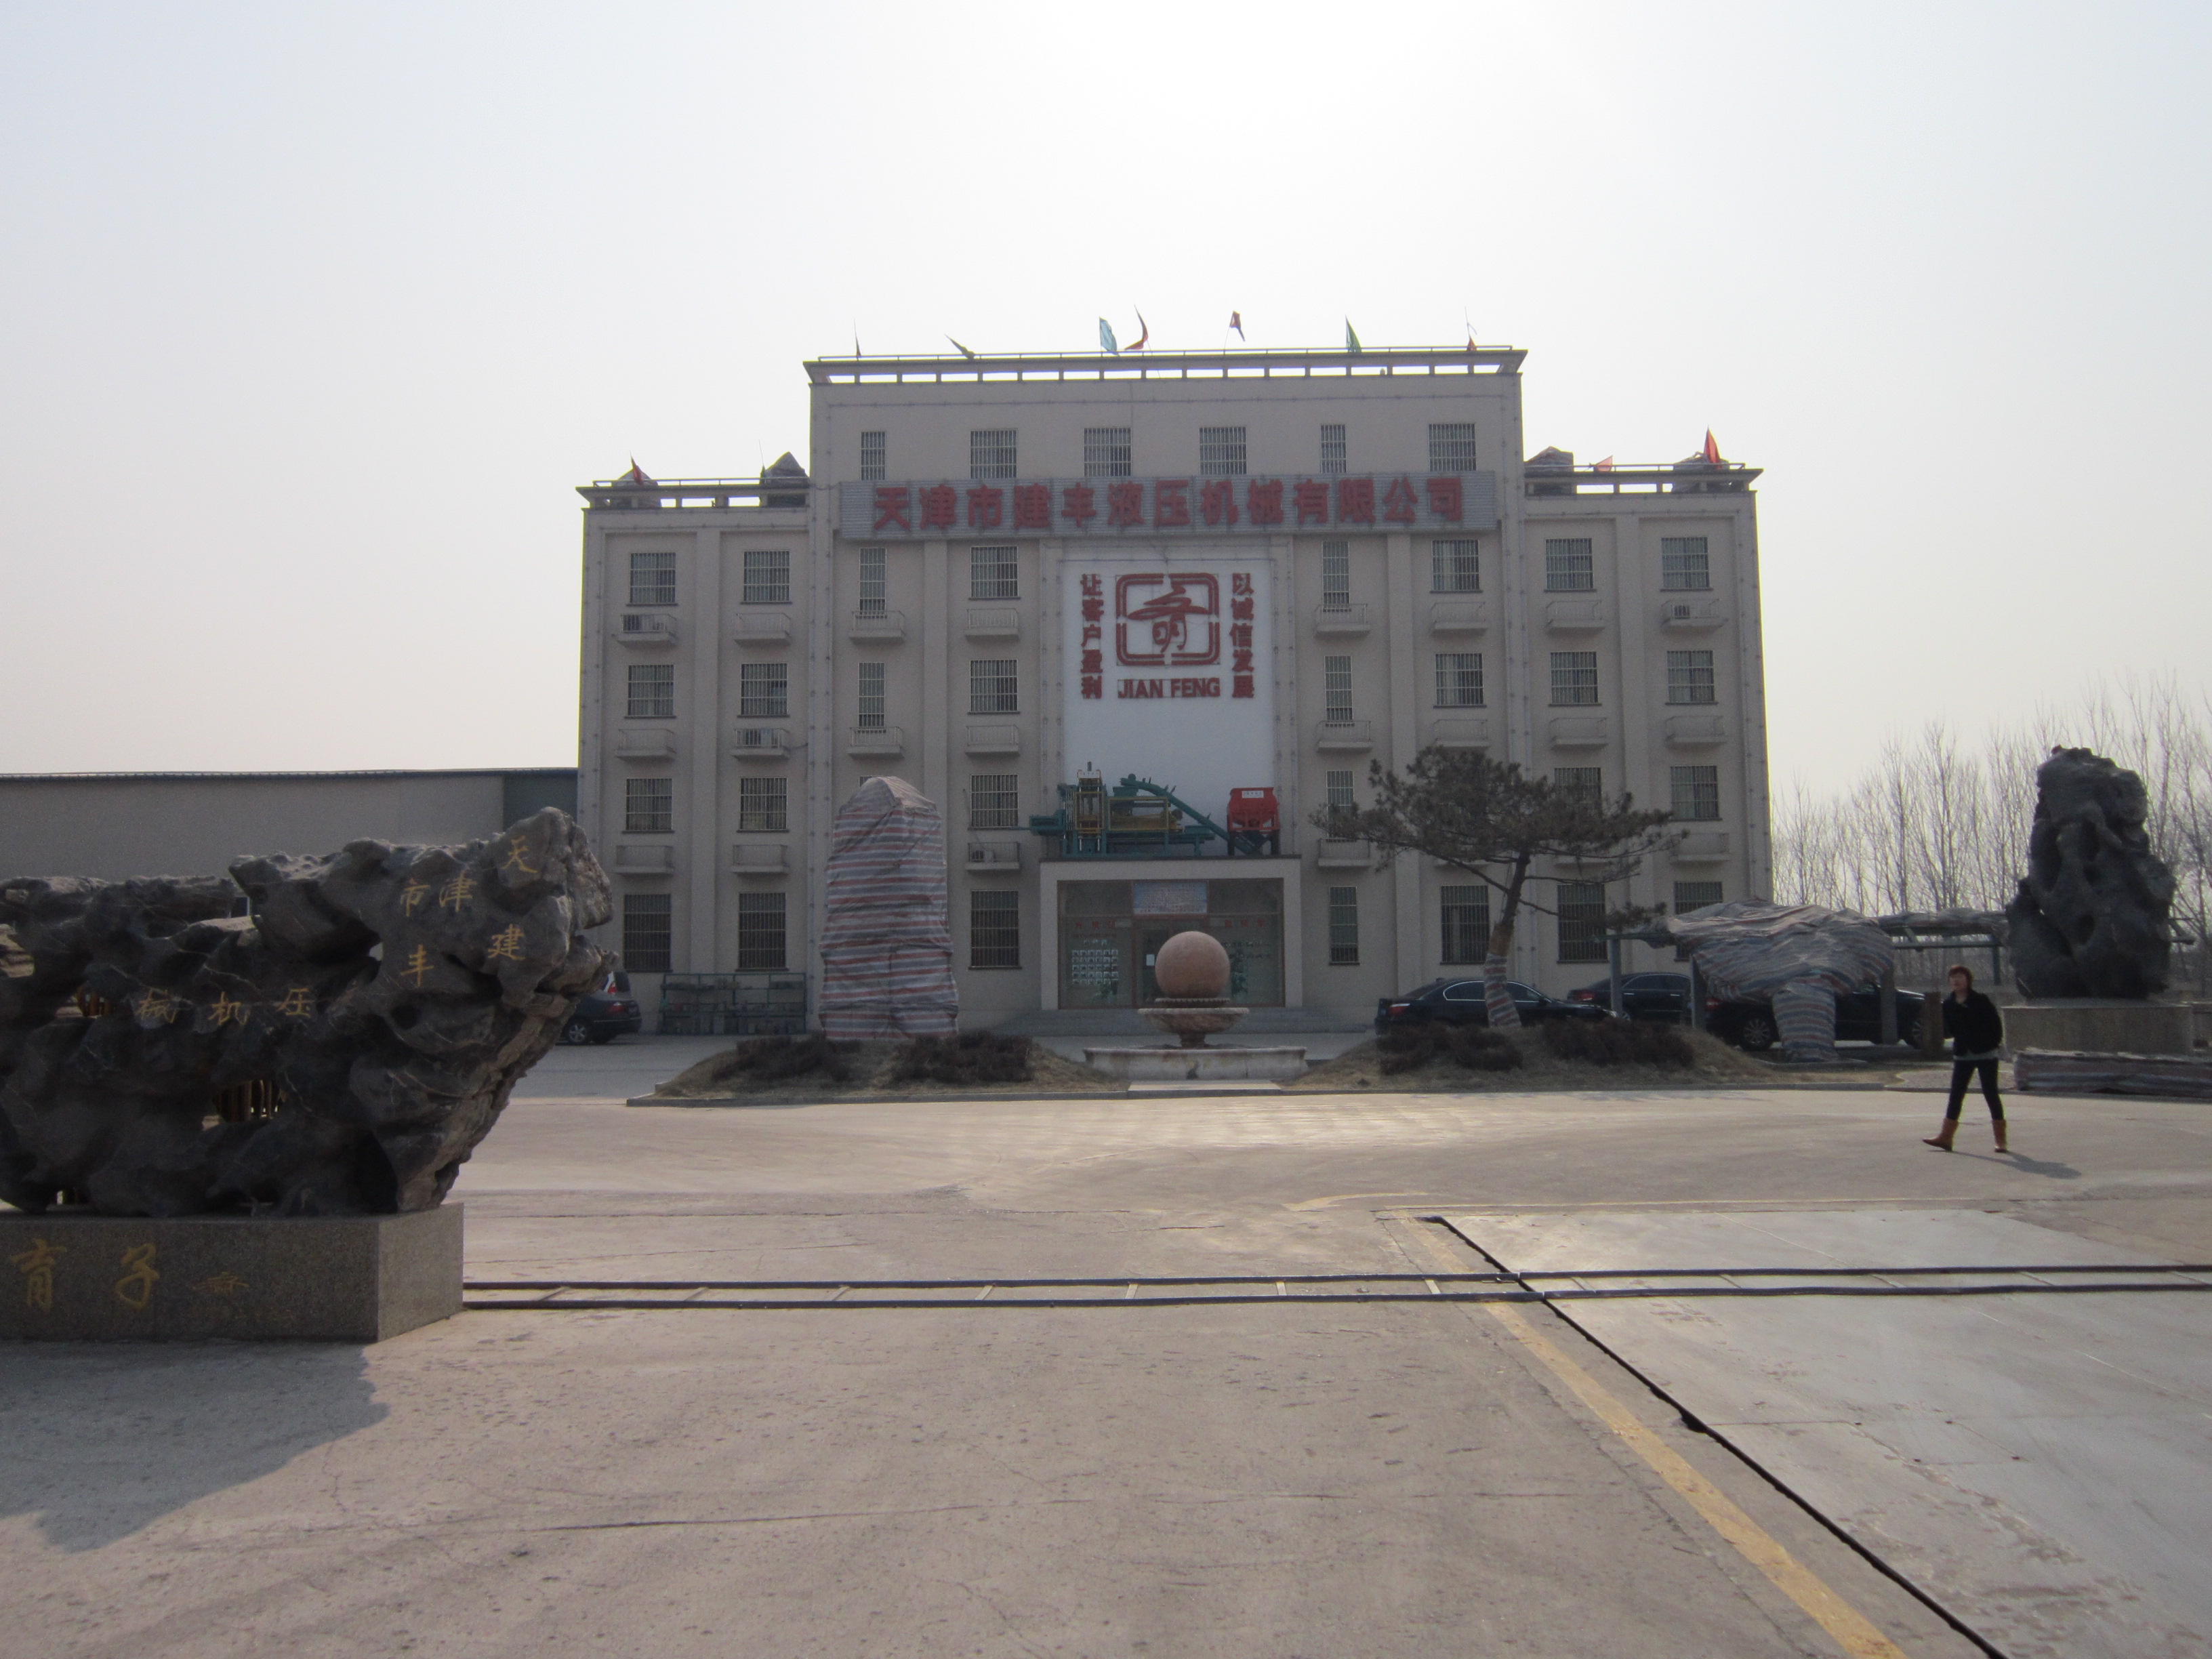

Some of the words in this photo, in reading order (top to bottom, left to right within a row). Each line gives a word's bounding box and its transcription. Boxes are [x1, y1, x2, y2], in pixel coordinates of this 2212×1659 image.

[874, 476, 1463, 530] 天津市建丰液压机械有限公司
[1080, 573, 1104, 699] 让客户盈利
[1229, 573, 1254, 698] 以诚信发展
[1118, 679, 1163, 698] JIAN
[1170, 678, 1221, 697] FENG
